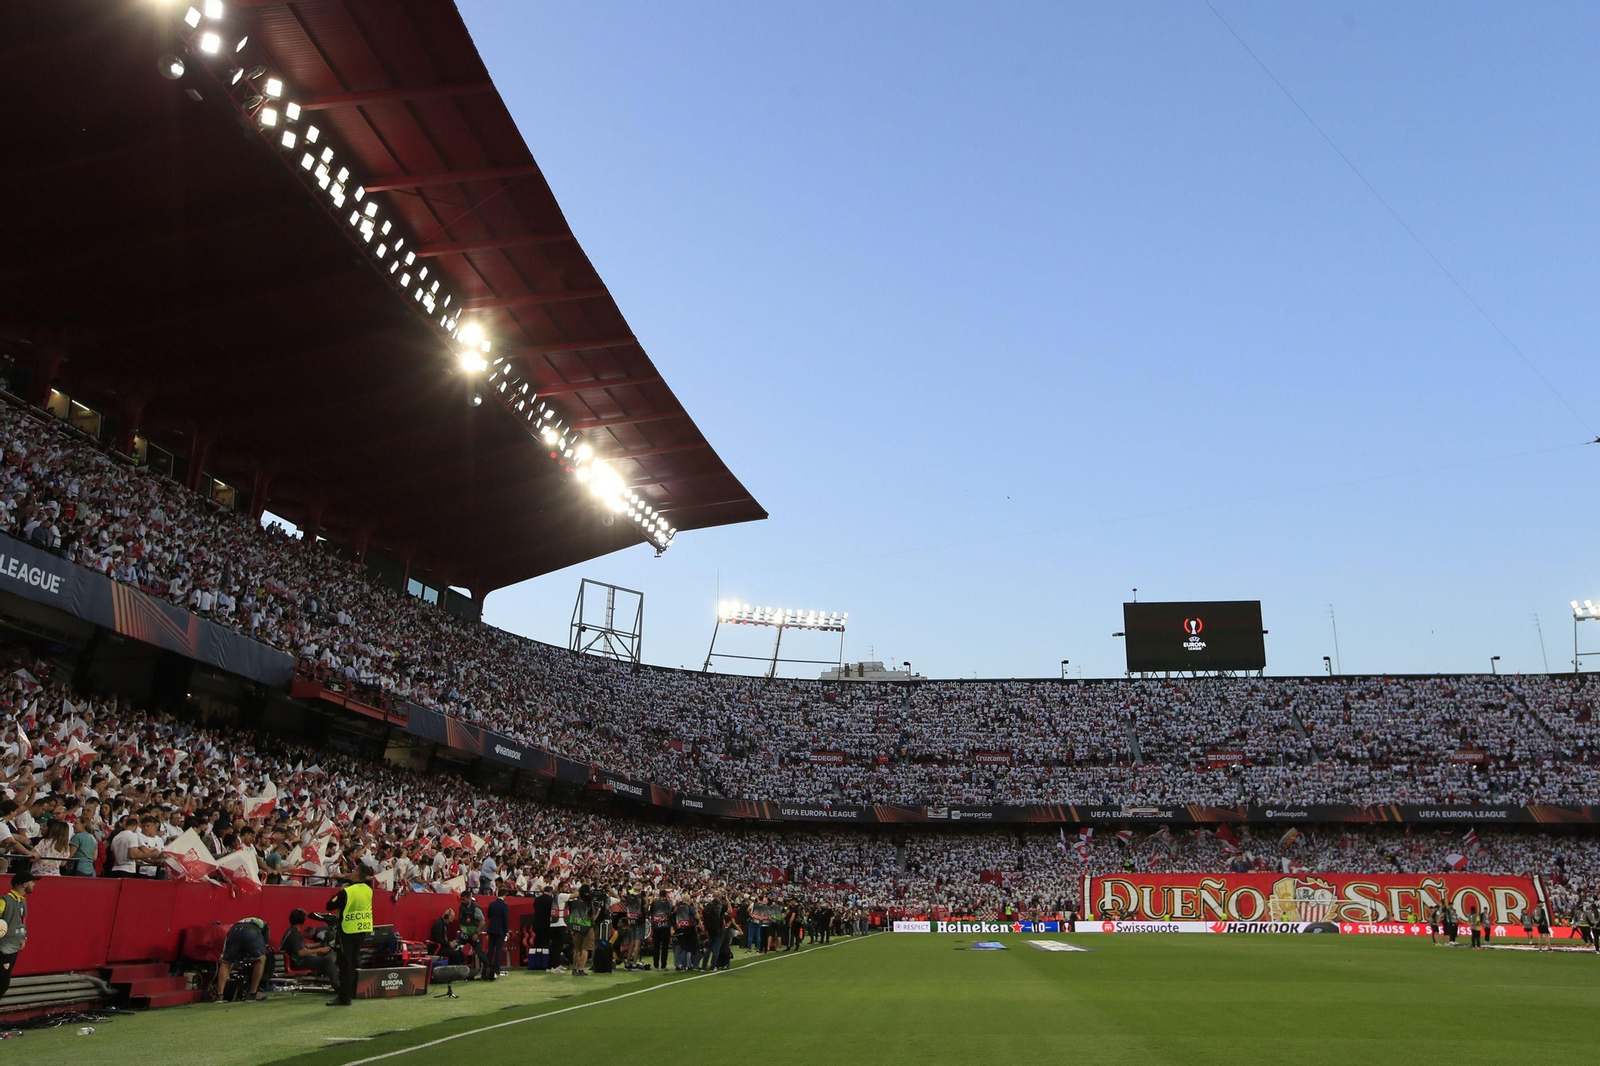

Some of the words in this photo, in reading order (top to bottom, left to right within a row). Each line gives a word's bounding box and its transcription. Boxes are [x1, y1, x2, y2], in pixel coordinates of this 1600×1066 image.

[0, 554, 60, 594] LEAGUE
[976, 754, 1010, 762] Cruzcampo
[781, 808, 799, 816] UEFA
[800, 809, 828, 817] EUROPA
[828, 810, 857, 818] LEAGUE
[1273, 810, 1308, 818] Swissquote
[1419, 810, 1441, 818] UEFA
[1441, 810, 1474, 818] EUROPA
[1474, 810, 1507, 818] LEAGUE
[1098, 879, 1265, 921] DUEÑO
[1340, 878, 1528, 924] SEÑOR
[344, 912, 372, 922] SECUR
[357, 922, 371, 930] 282
[937, 921, 1009, 933] Heineken
[1116, 922, 1179, 932] Swissquote
[1358, 925, 1405, 934] STRAUSS
